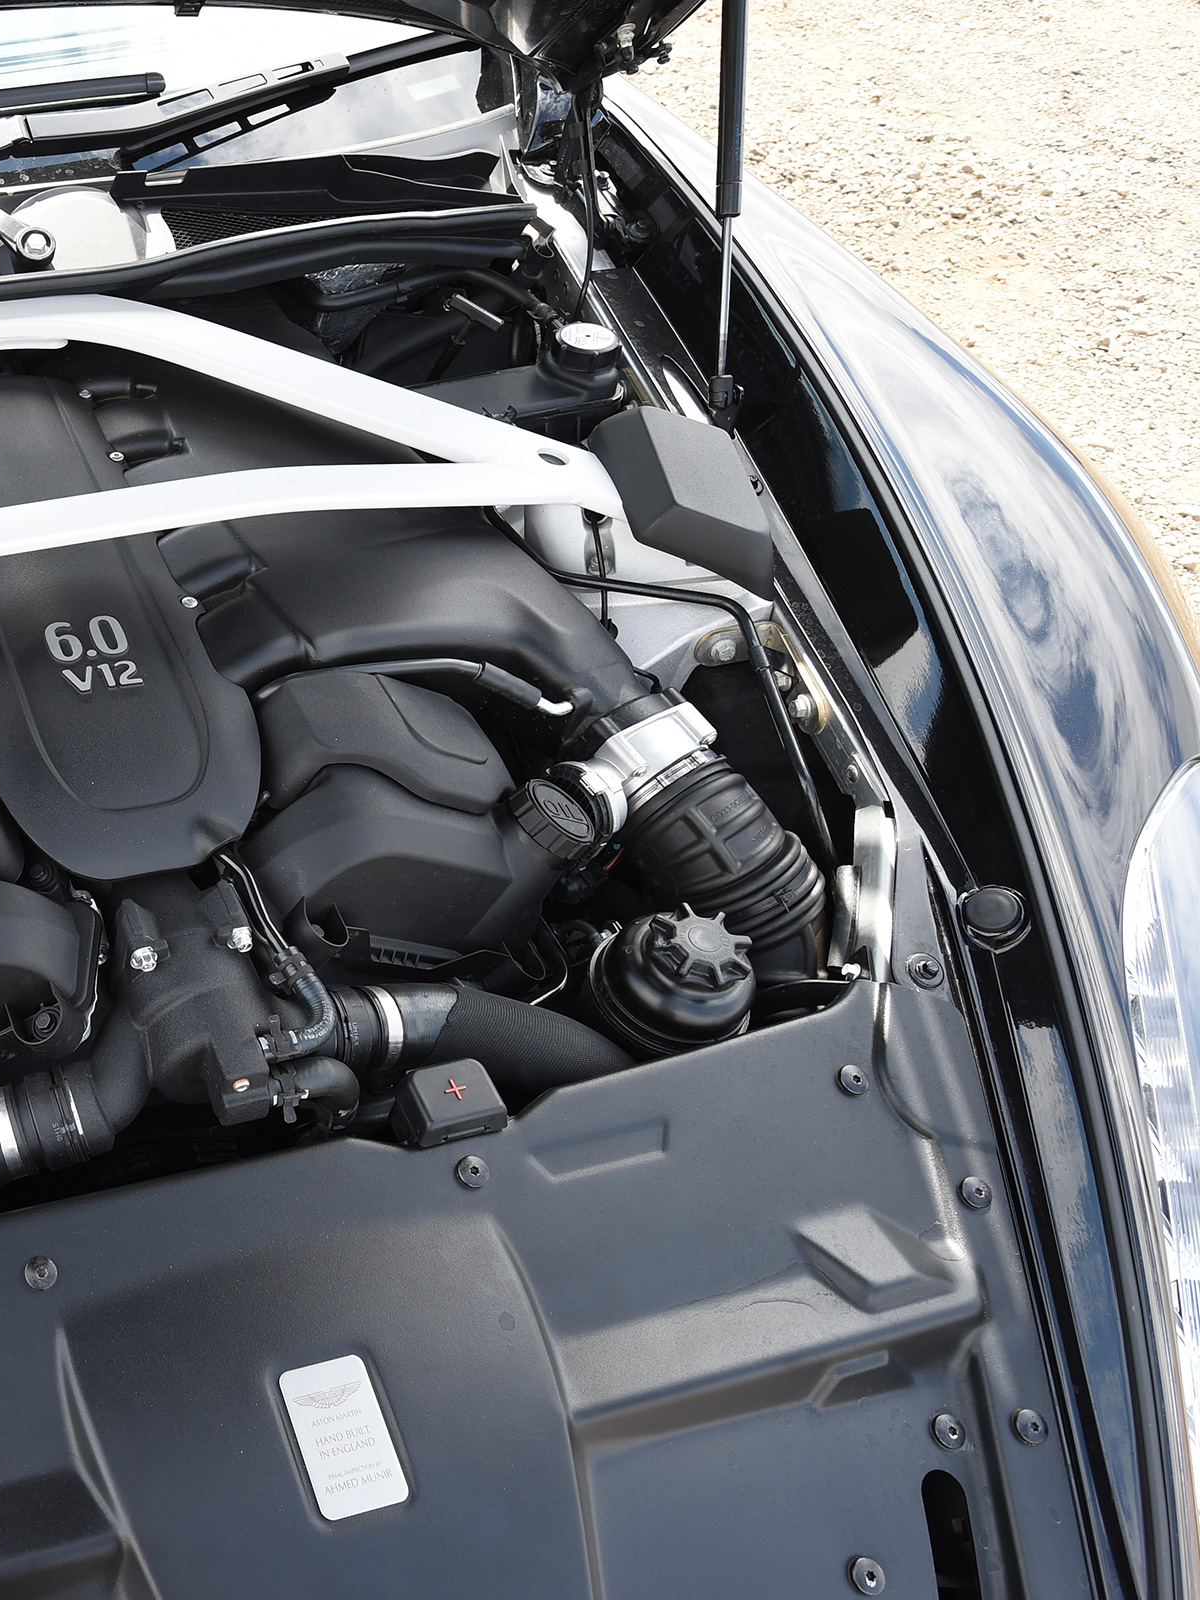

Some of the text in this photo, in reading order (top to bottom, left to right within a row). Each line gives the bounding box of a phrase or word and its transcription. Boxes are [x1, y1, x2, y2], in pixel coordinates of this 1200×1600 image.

[44, 615, 129, 663] 6.0
[61, 660, 144, 694] V12
[543, 798, 584, 822] OIL
[312, 1408, 362, 1427] ASTON MARTIN
[315, 1425, 370, 1447] HAND BUILT
[319, 1437, 376, 1460] IN ENGLAND
[325, 1468, 393, 1495] AHMED MUNIR
[328, 1471, 343, 1480] FINAL
[344, 1462, 375, 1476] INSPECTION
